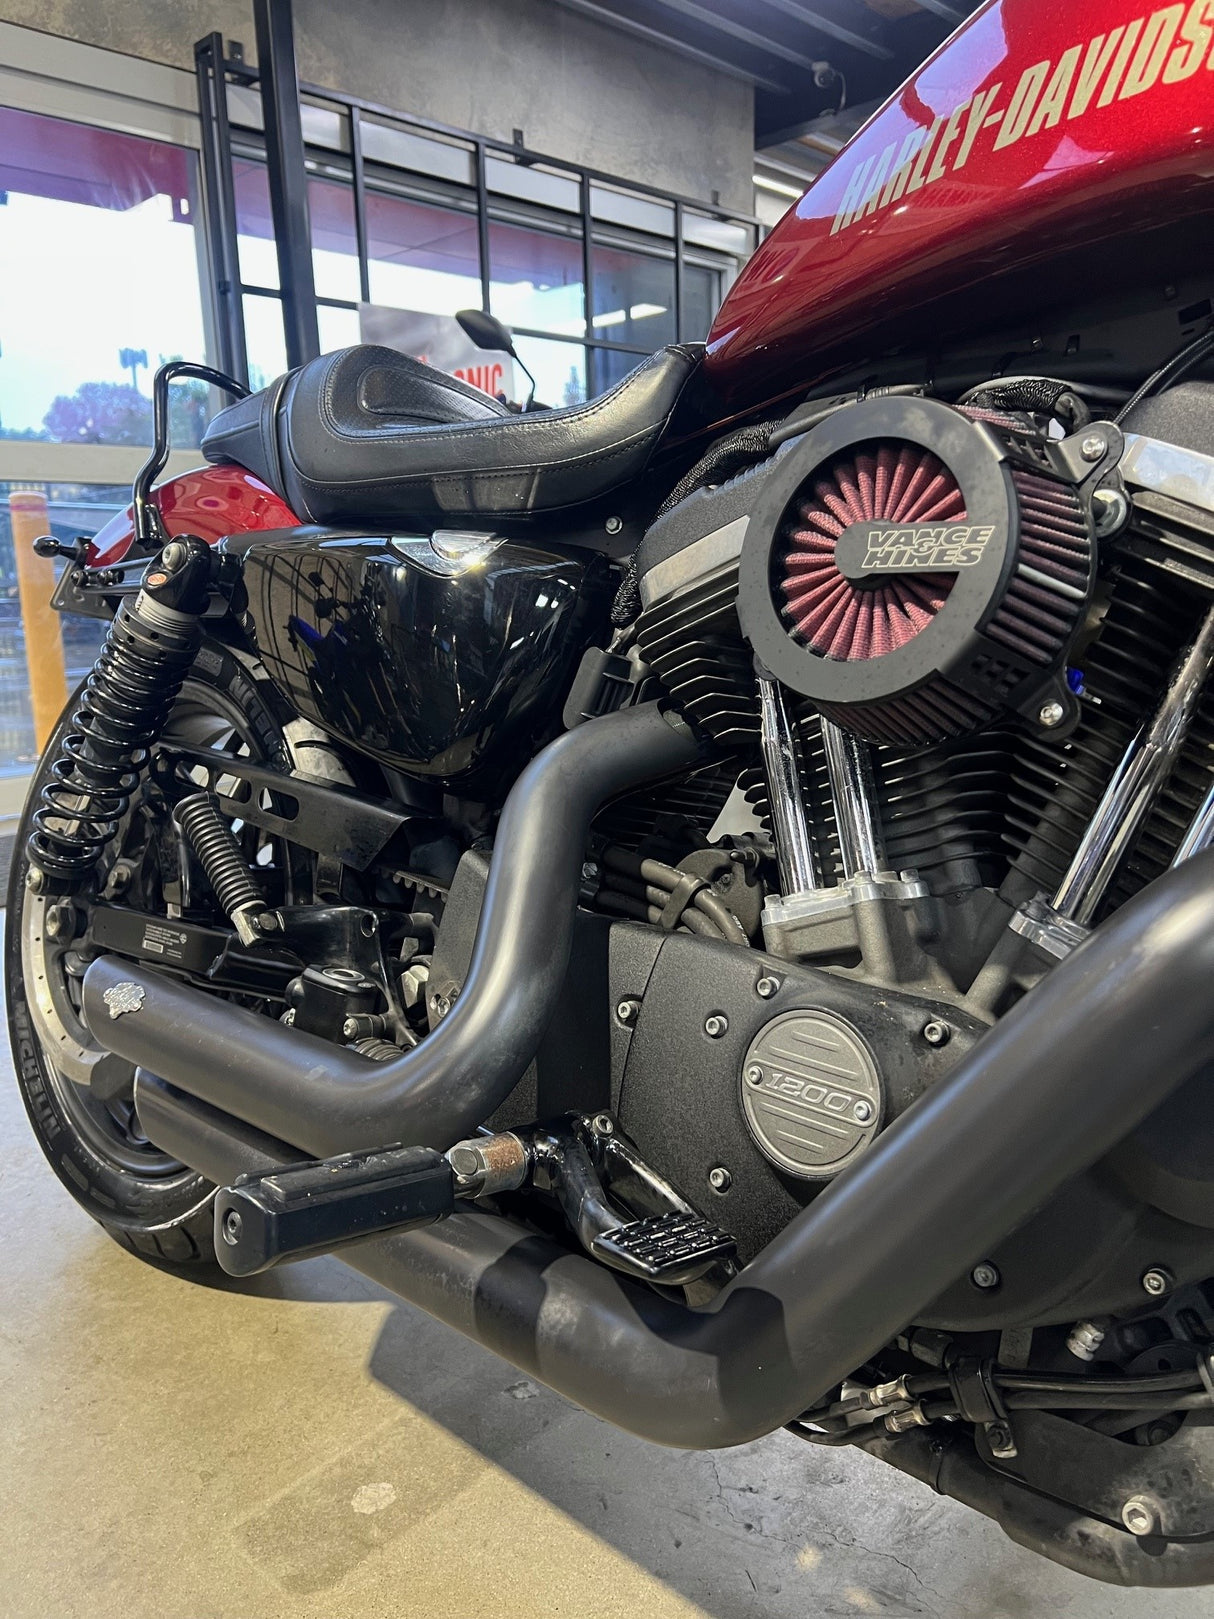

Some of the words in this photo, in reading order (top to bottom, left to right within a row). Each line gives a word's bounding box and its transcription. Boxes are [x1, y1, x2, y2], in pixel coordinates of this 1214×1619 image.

[829, 0, 1214, 237] HARLEY-DAVIDS
[861, 545, 984, 569] HINES
[867, 525, 996, 551] VANCE
[13, 1000, 62, 1140] MICHELIN
[765, 1073, 853, 1112] 1200
